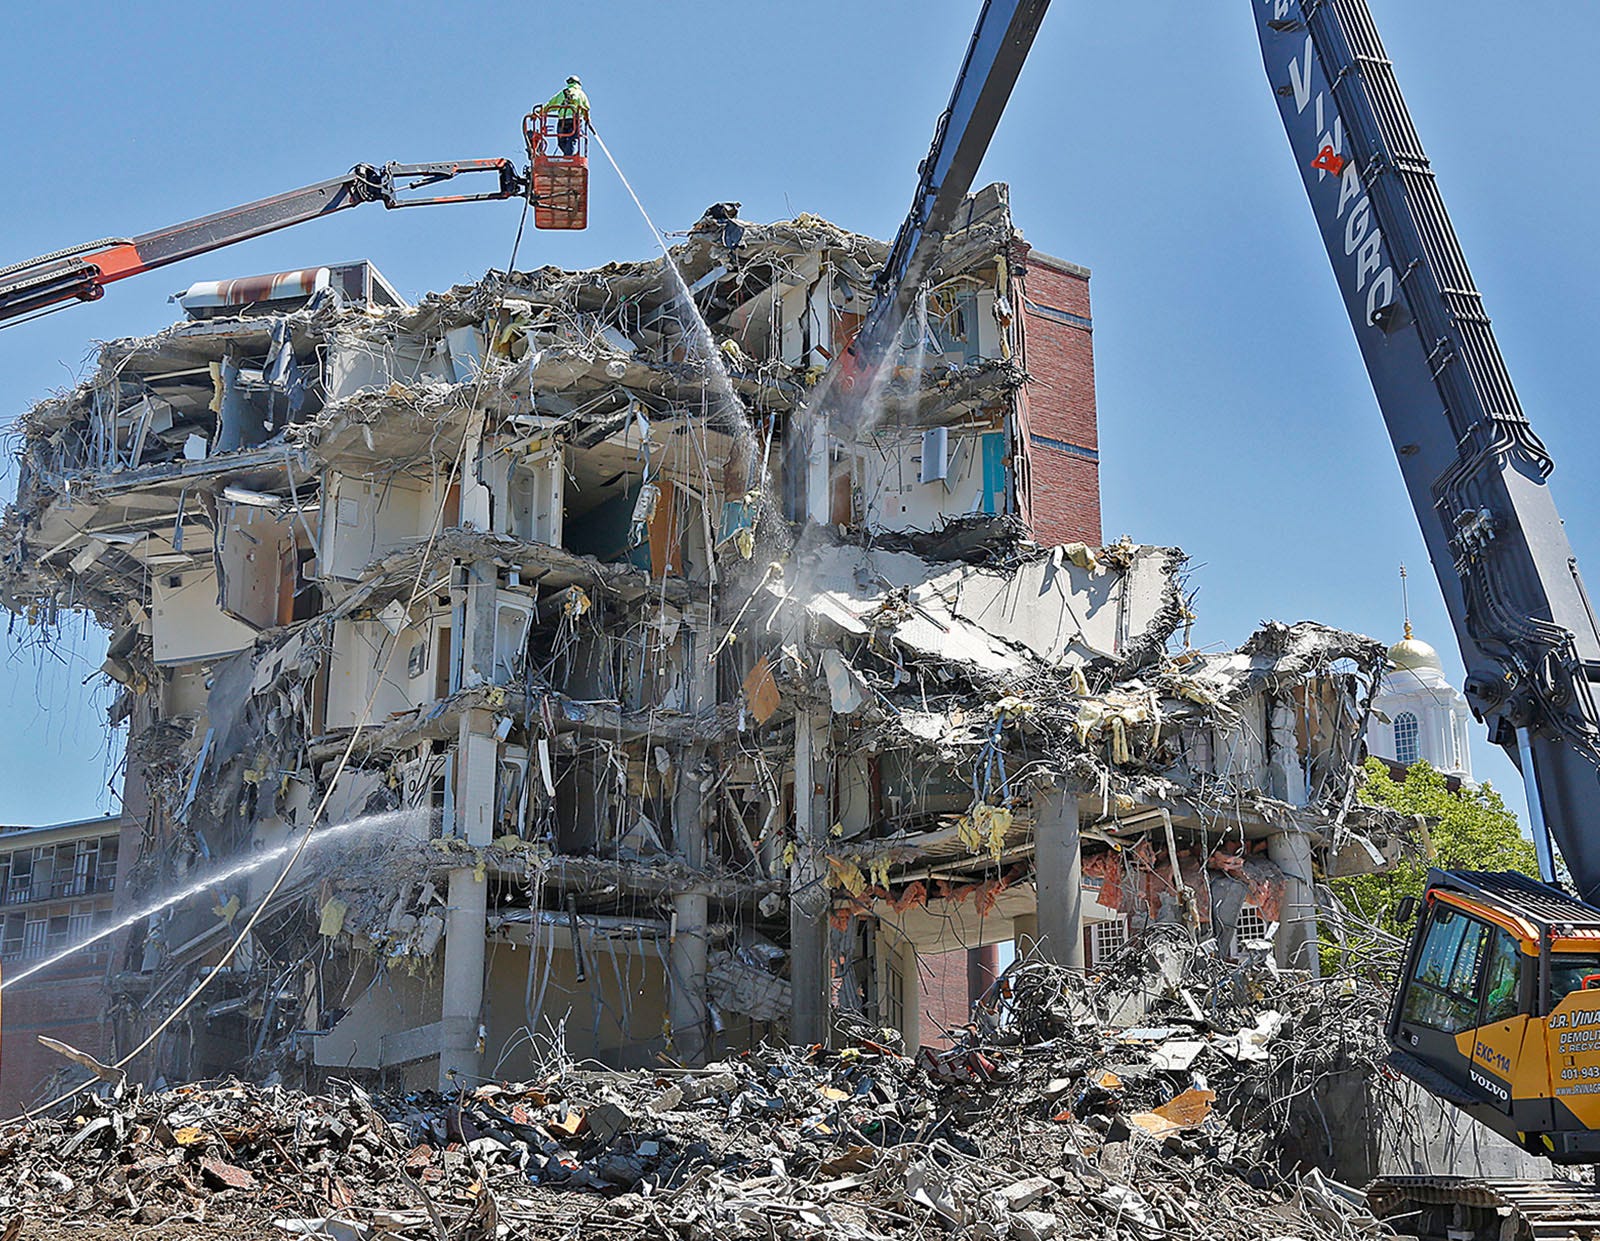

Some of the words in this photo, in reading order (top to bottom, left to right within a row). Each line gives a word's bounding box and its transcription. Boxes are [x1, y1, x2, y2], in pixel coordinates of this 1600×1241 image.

[1288, 34, 1393, 327] VINAGRO
[1549, 1014, 1569, 1028] J.R.
[1475, 1041, 1511, 1073] EXC-114
[1470, 1069, 1509, 1100] VOLVO
